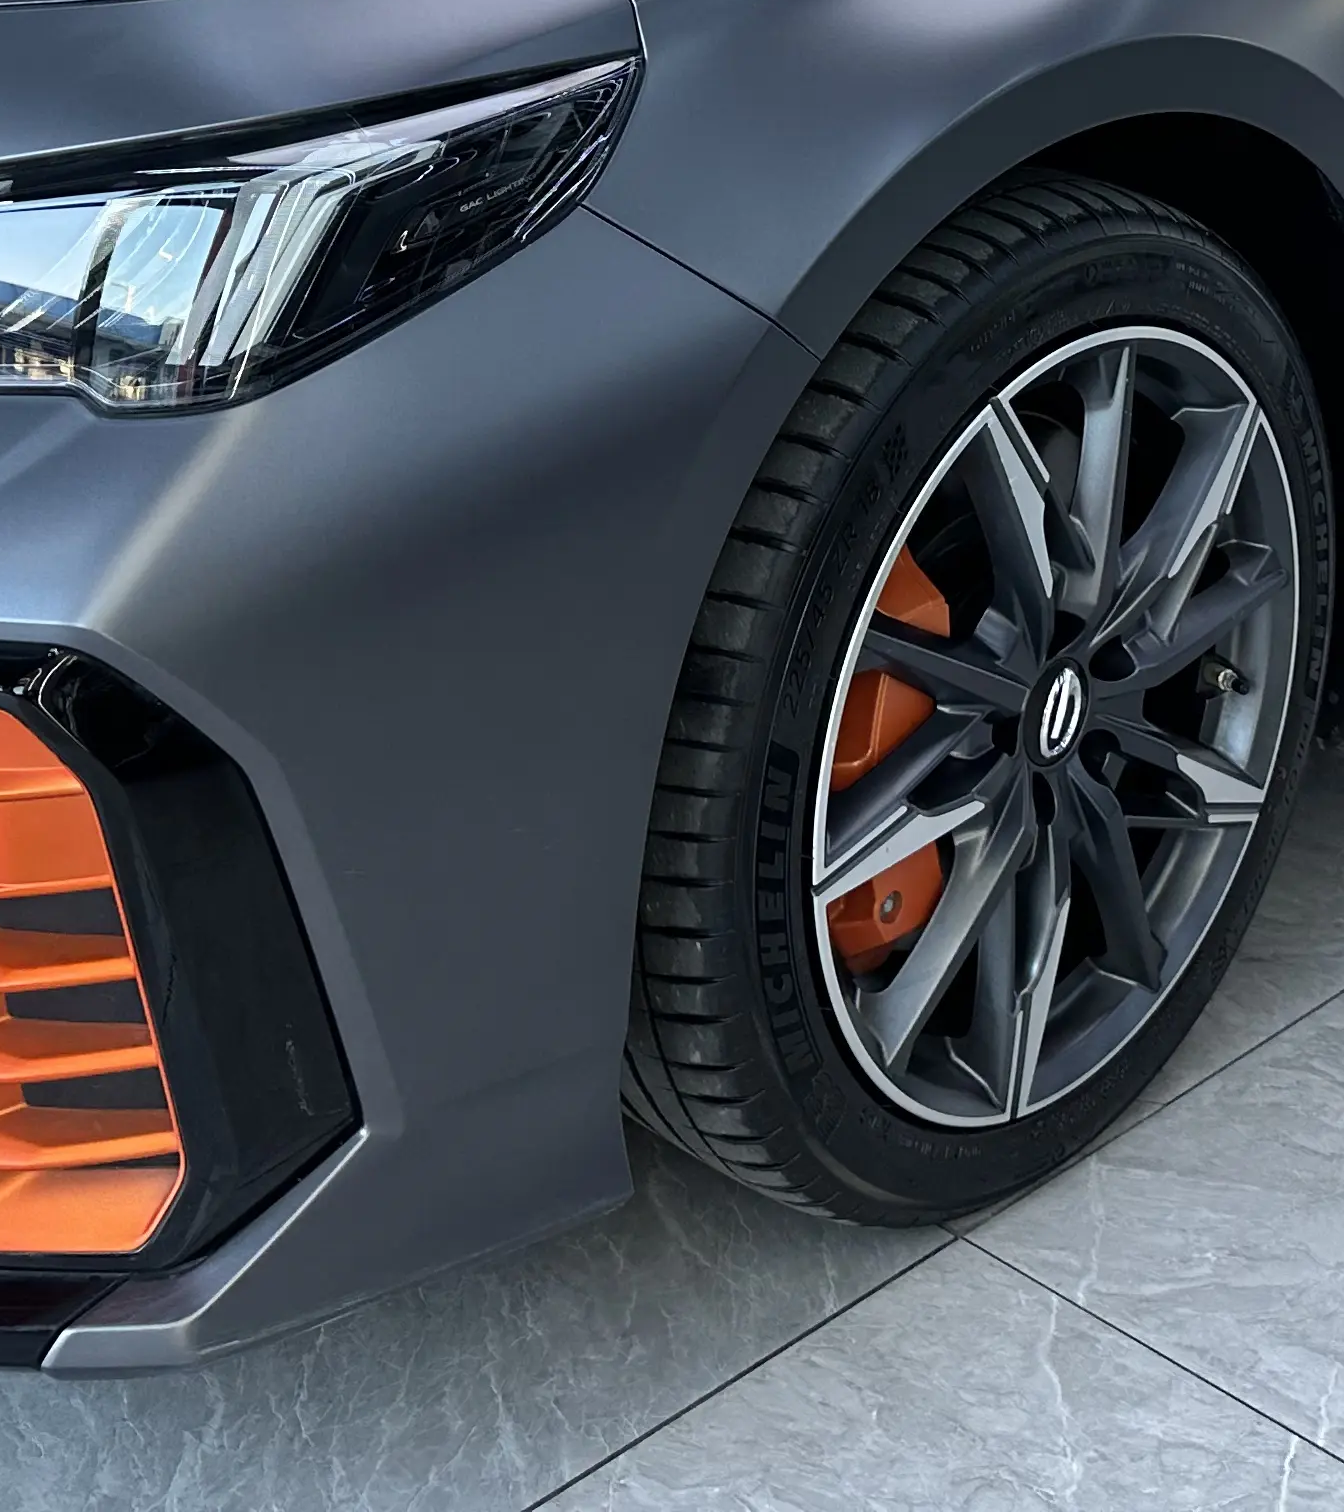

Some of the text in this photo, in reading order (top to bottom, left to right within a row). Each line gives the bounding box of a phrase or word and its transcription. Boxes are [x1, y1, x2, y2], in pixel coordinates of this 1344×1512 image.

[459, 196, 484, 213] GAC
[1300, 426, 1329, 683] MICHELIN
[756, 764, 815, 1076] MICHELIN
